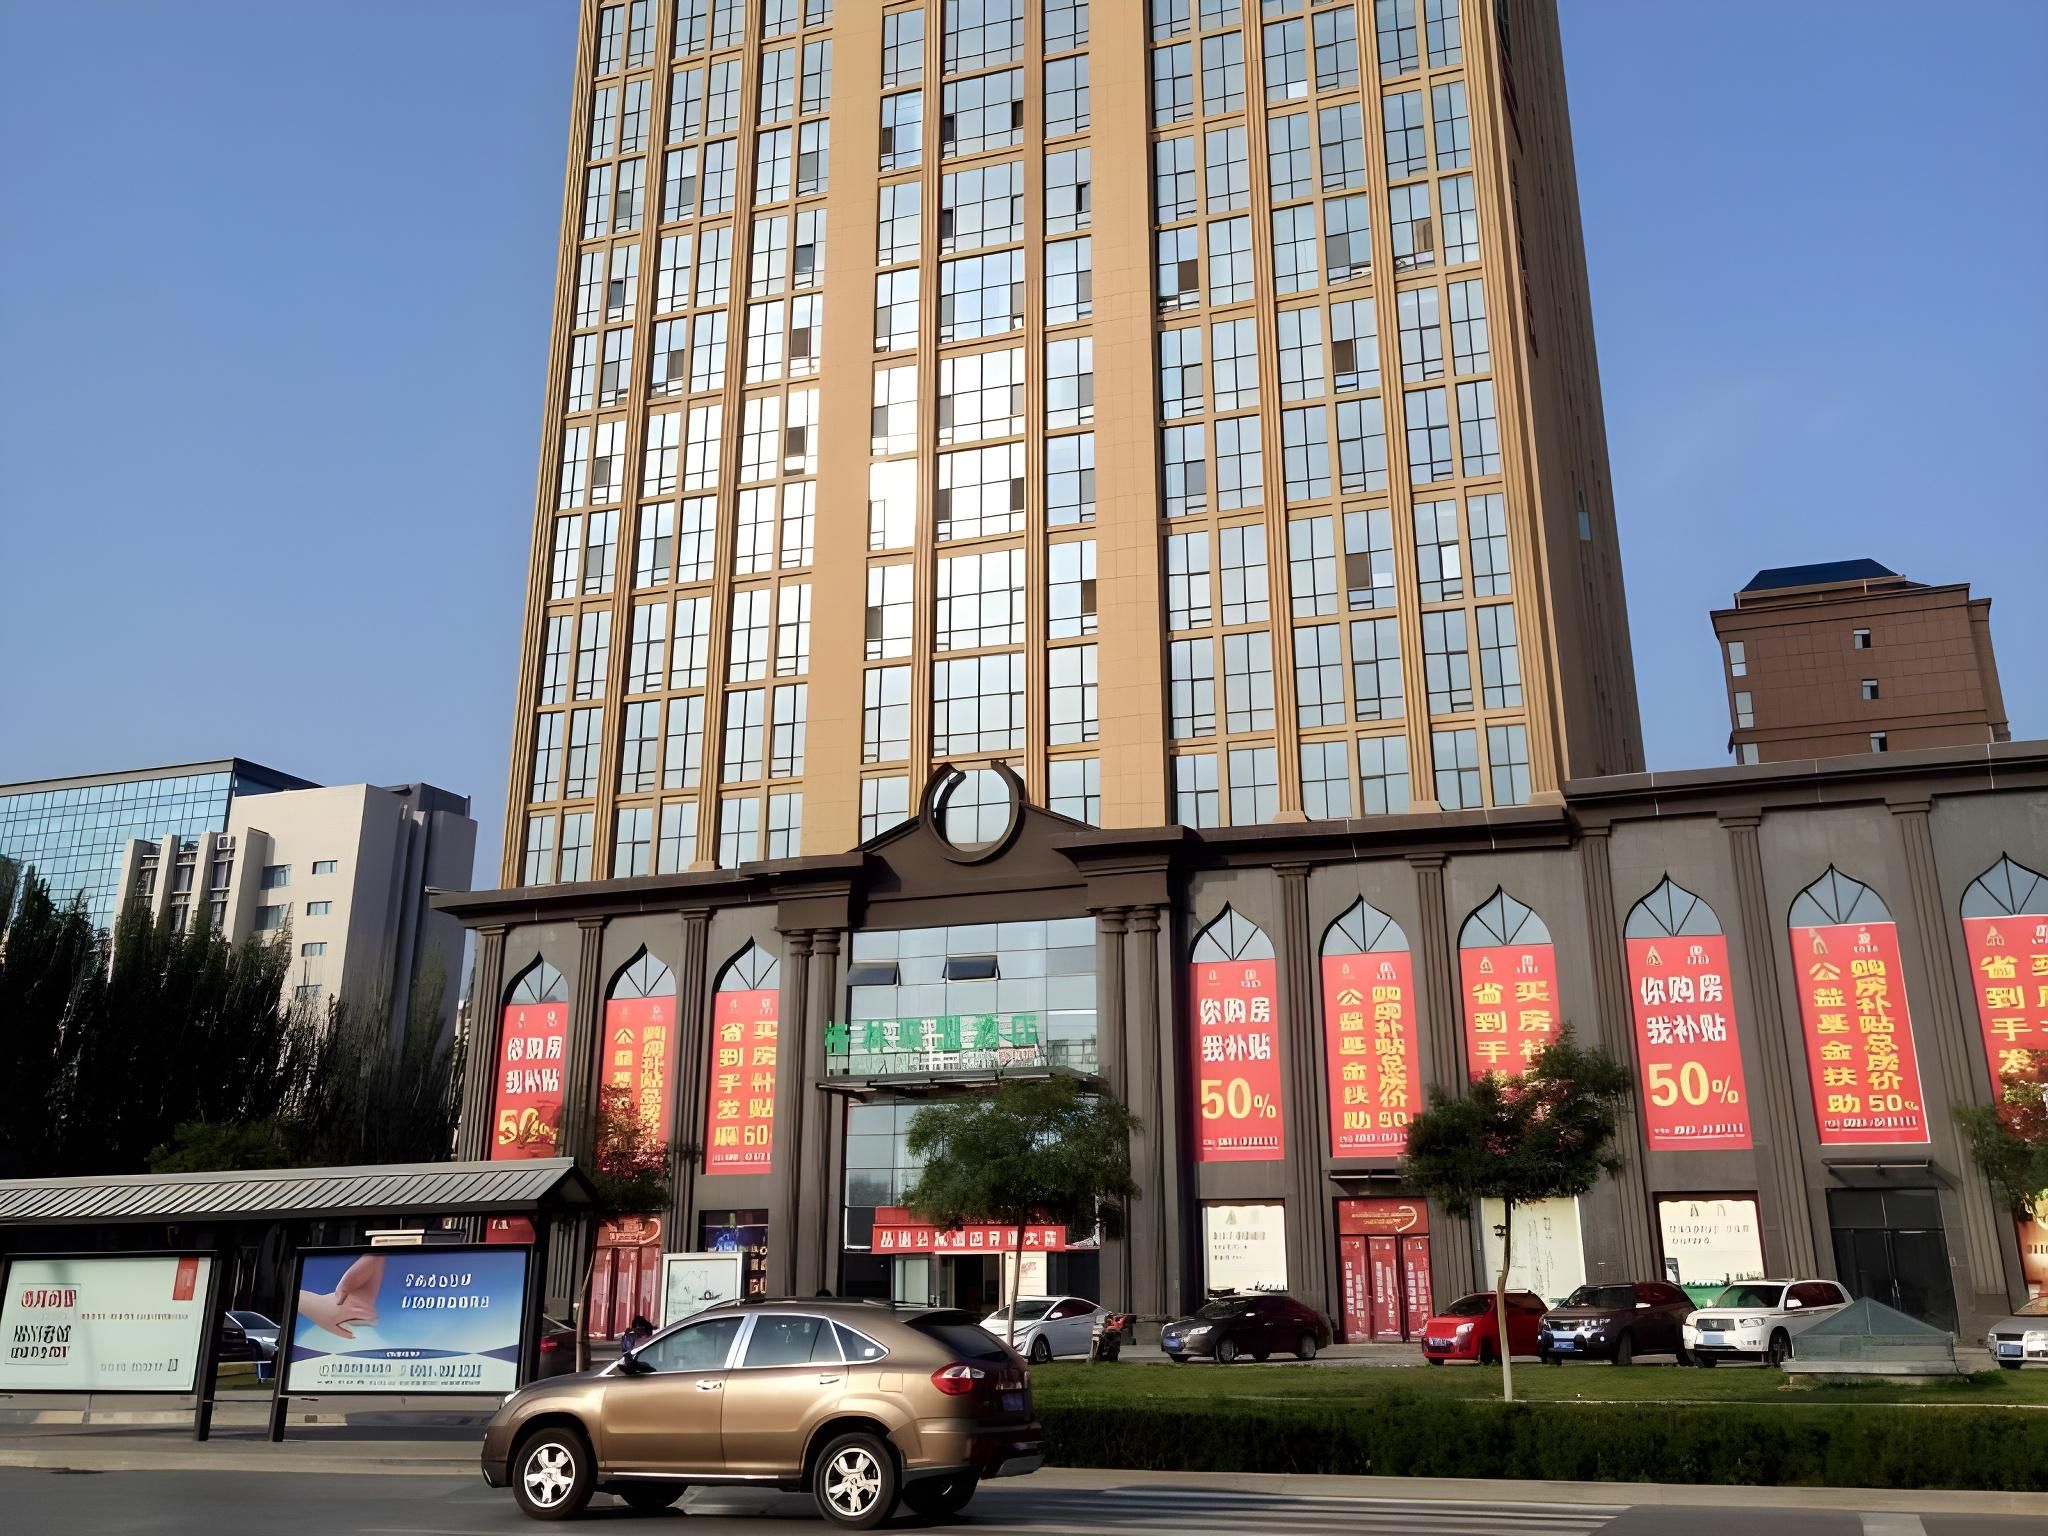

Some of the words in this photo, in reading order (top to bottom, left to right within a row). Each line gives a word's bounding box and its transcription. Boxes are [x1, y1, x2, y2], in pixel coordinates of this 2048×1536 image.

[1641, 974, 1723, 1006] 你购房
[1199, 996, 1271, 1025] 你购房
[1472, 982, 1510, 1082] 省到手
[1647, 1013, 1727, 1045] 我补贴
[1202, 1032, 1271, 1062] 我补贴
[1200, 1077, 1277, 1120] 50%
[1648, 1061, 1740, 1107] 50%
